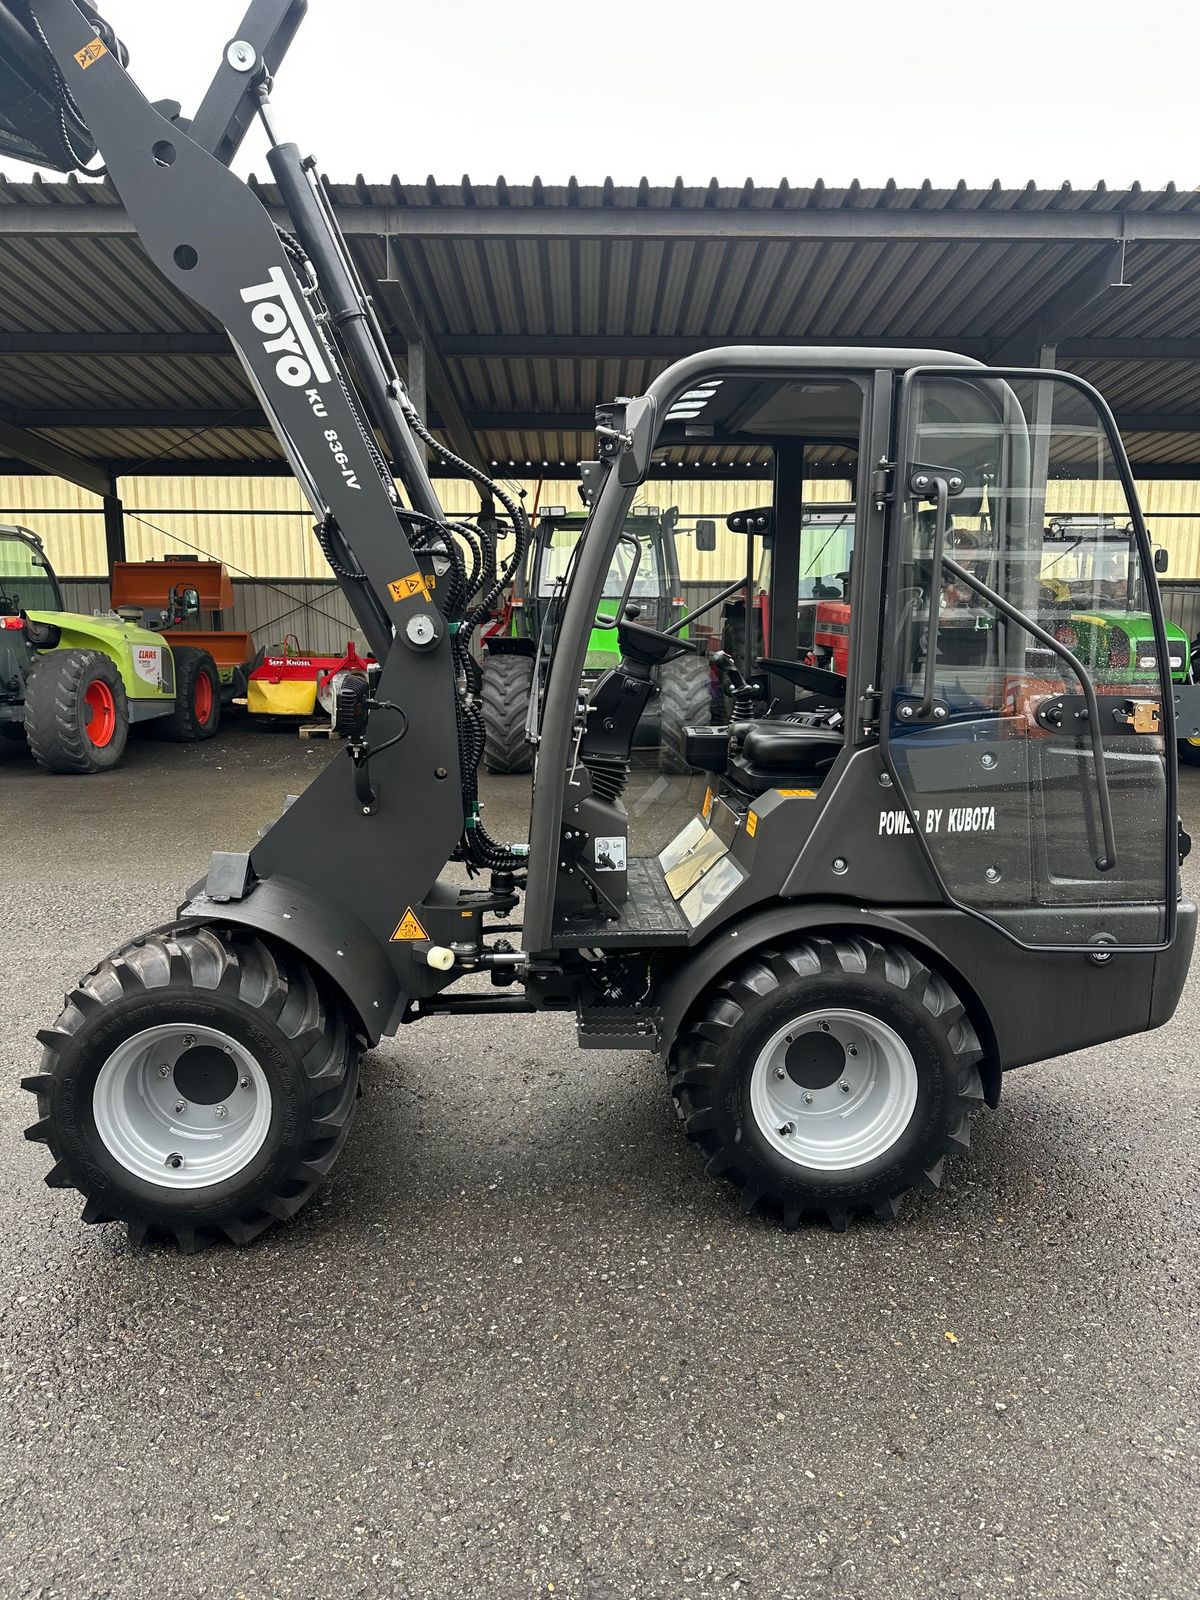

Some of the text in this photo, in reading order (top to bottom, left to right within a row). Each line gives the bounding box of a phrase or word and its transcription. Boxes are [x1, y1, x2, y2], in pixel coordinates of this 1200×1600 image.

[239, 266, 332, 387] TOYO
[304, 388, 362, 490] KU 836-IV
[138, 650, 157, 659] CLAAS
[925, 809, 943, 833] BY
[948, 807, 995, 832] KUBOTA
